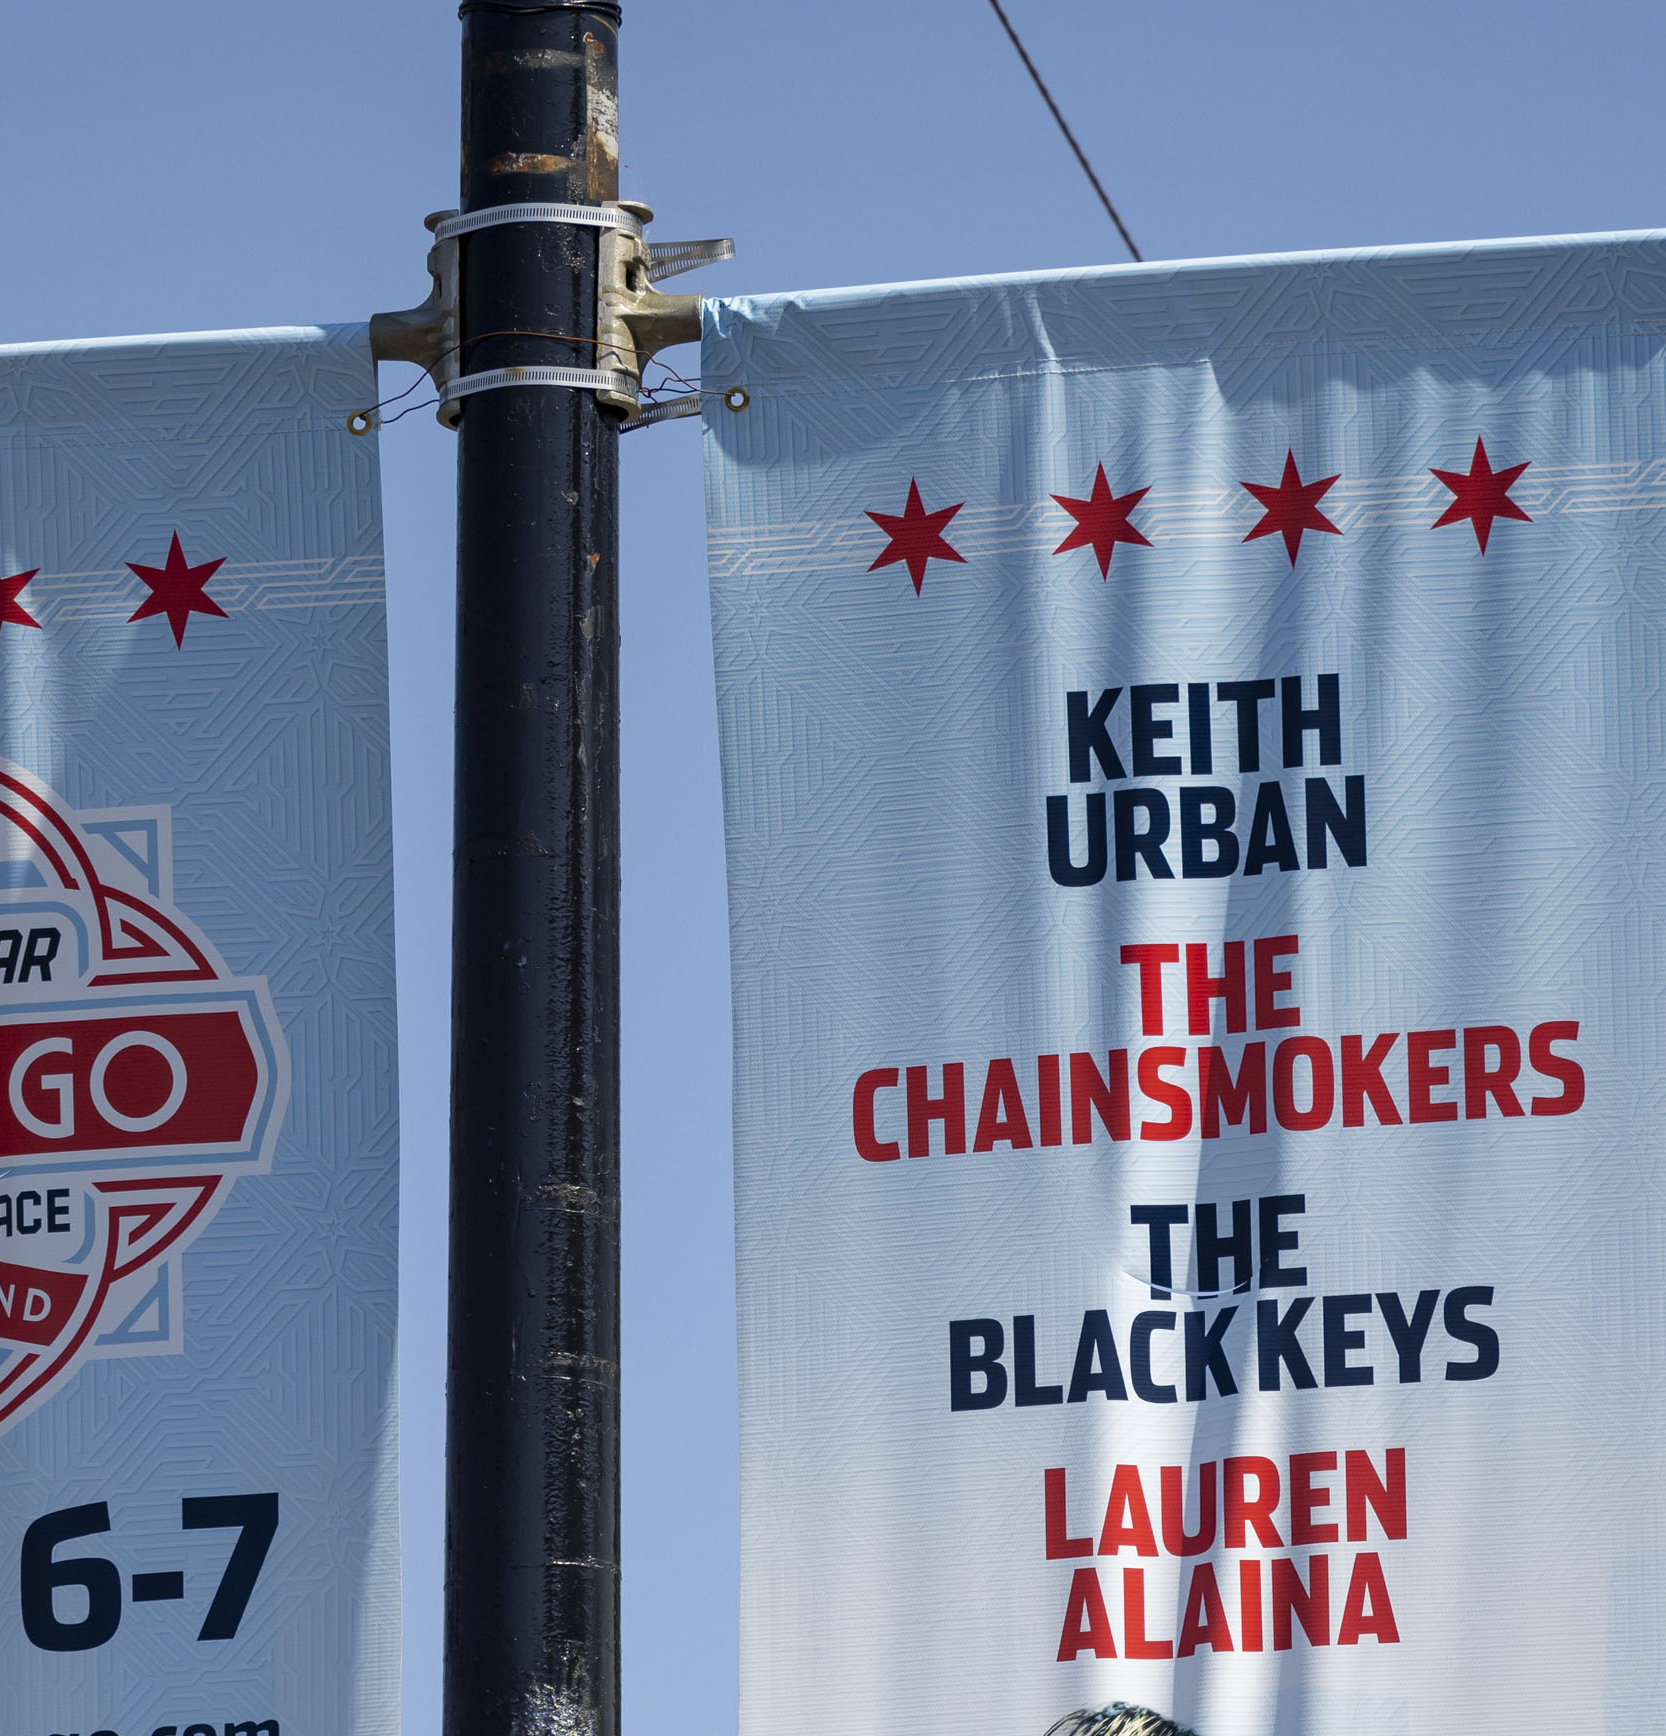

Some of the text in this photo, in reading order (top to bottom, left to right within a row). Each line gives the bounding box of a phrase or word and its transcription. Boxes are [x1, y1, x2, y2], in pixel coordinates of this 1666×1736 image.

[1067, 673, 1342, 782] KEITH
[1046, 774, 1367, 887] URBAN
[1120, 934, 1300, 1037] THE
[851, 1021, 1585, 1162] CHAINSMOKERS
[1130, 1194, 1307, 1301] THE
[950, 1285, 1500, 1412] BLACK KEYS
[1044, 1447, 1408, 1560] LAUREN
[21, 1491, 280, 1652] 6-7
[1057, 1552, 1401, 1663] ALAINA
